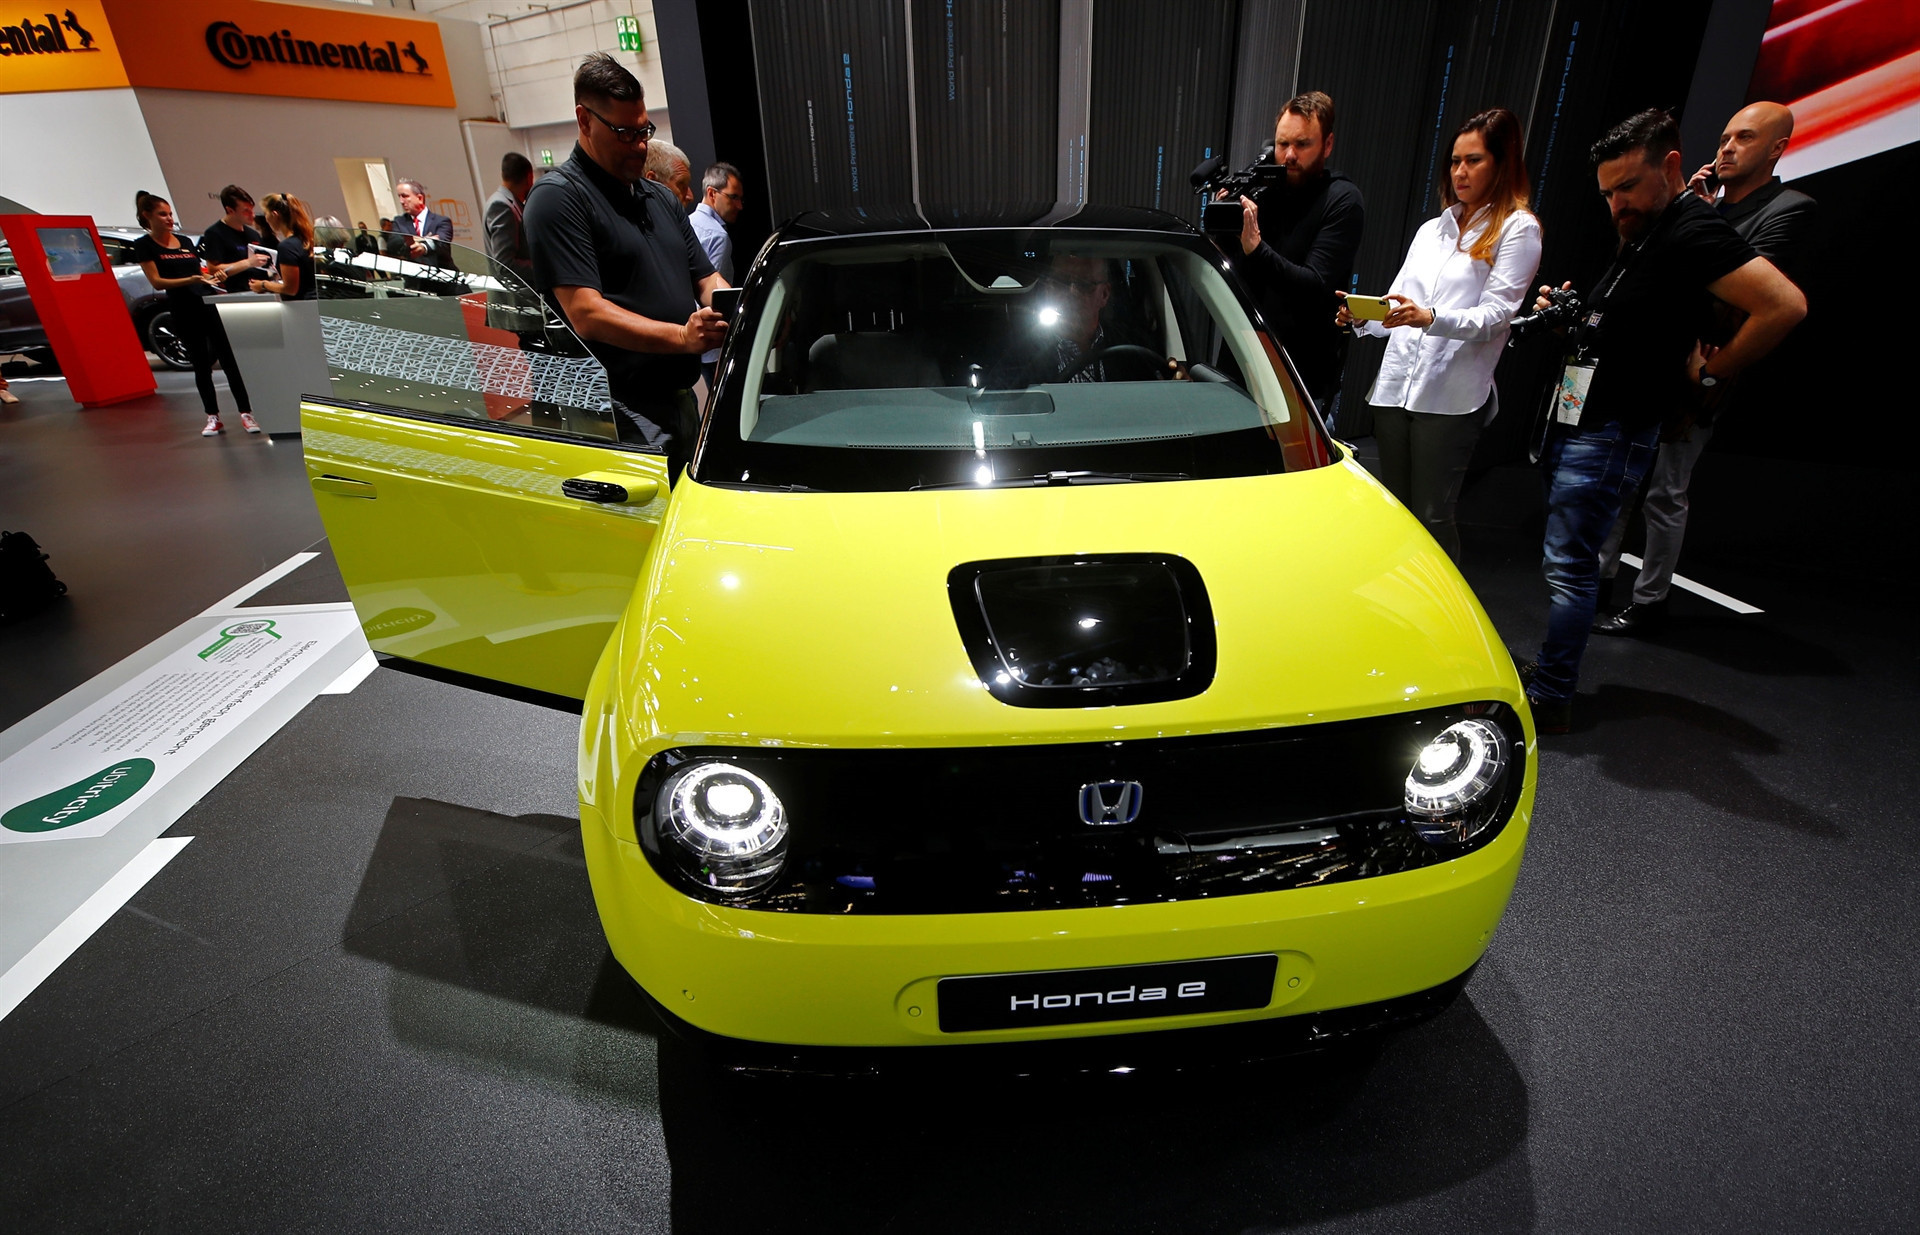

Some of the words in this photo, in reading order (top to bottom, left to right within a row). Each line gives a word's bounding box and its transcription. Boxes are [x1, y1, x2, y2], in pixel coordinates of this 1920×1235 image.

[205, 20, 404, 73] Continental
[842, 53, 850, 64] e
[1554, 40, 1576, 118] Honda
[1571, 20, 1580, 36] e
[844, 67, 853, 122] Honda
[947, 71, 955, 101] World
[1422, 181, 1431, 213] World
[1428, 130, 1440, 181] Premiere
[1435, 60, 1452, 129] Honda
[1447, 45, 1455, 59] e
[163, 717, 217, 756] gemacht
[42, 766, 133, 824] ubitricity
[1010, 985, 1168, 1011] Honda
[1177, 981, 1207, 998] e
